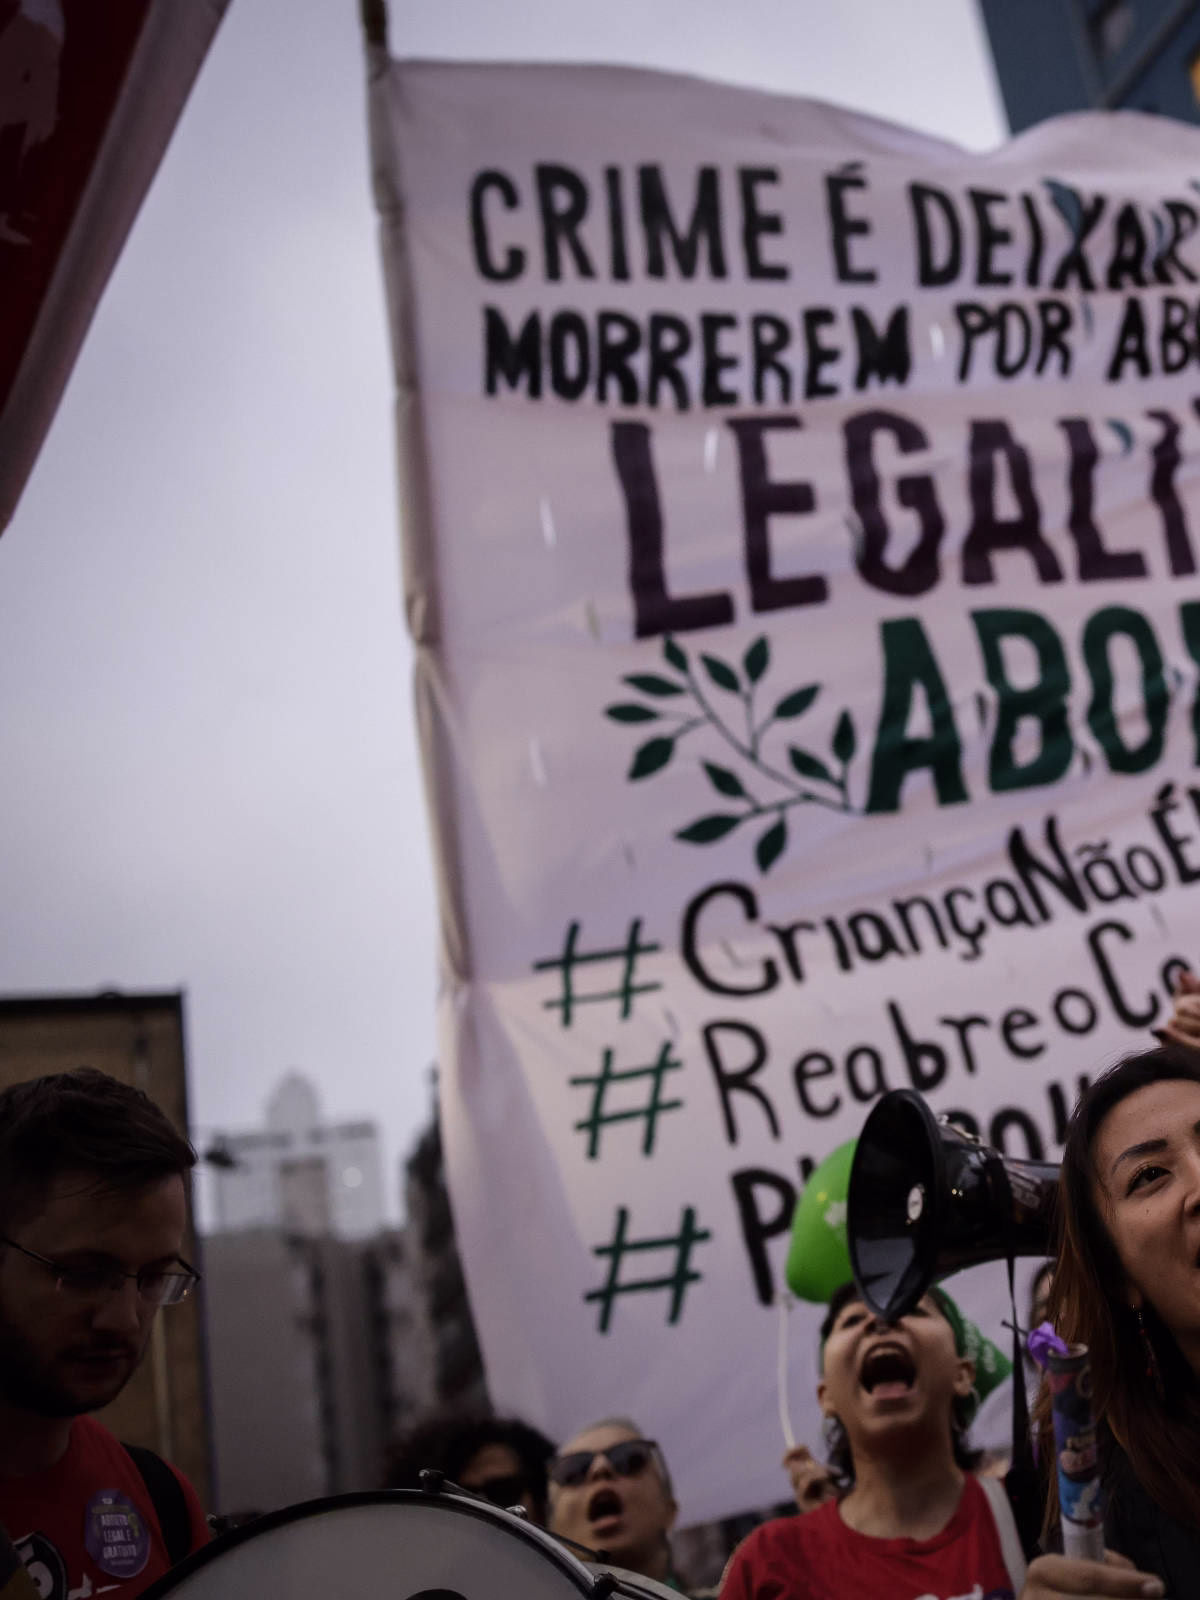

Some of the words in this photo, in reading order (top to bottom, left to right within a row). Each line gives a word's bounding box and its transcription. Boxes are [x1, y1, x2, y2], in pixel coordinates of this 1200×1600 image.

[469, 163, 790, 282] CRIME
[825, 162, 877, 283] É
[908, 178, 1200, 292] DEIXAR
[483, 302, 910, 412] MORREREM
[955, 302, 1074, 384] POR
